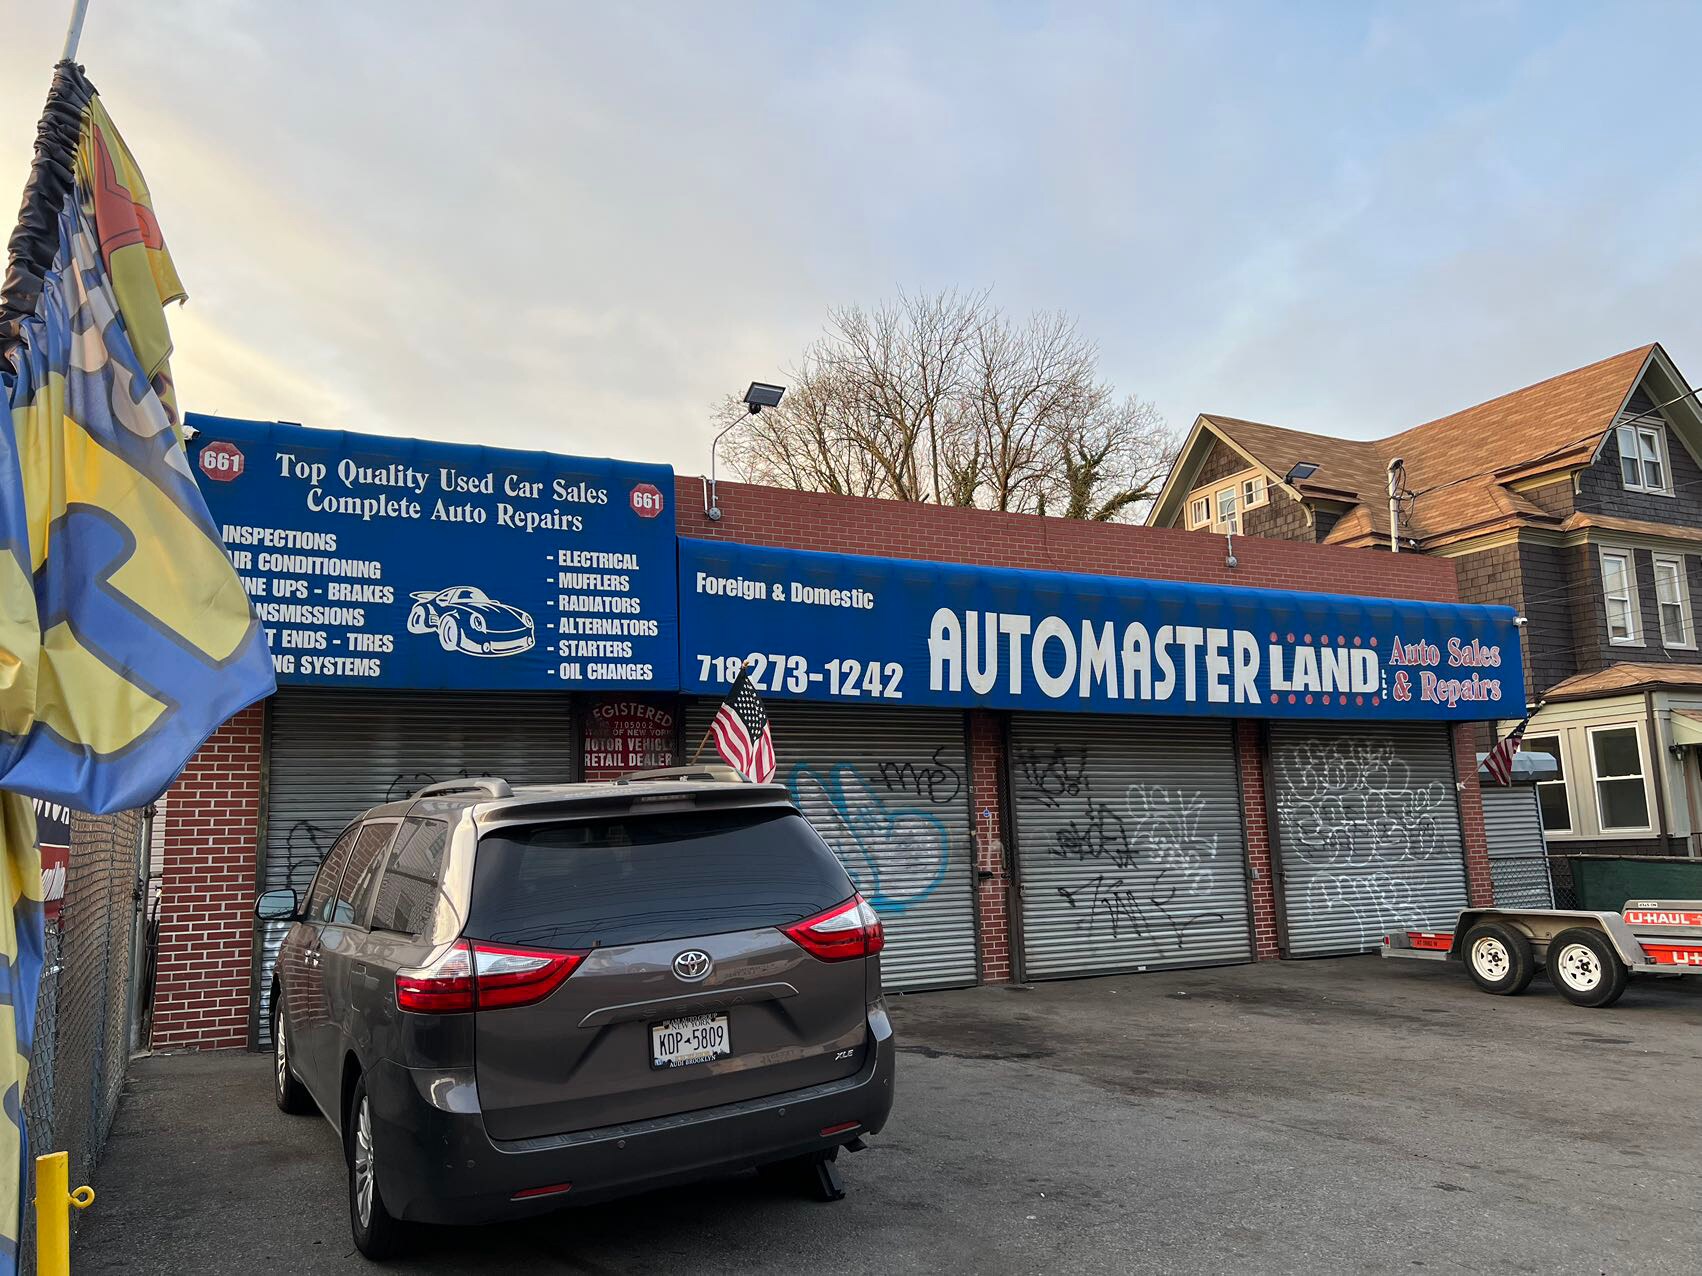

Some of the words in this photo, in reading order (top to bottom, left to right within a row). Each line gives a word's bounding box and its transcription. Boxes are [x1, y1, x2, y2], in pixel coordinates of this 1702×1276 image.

[203, 450, 240, 472] 661
[276, 453, 326, 485] Top
[337, 459, 429, 493] Quality
[440, 469, 494, 494] Used
[504, 475, 543, 498] Car
[553, 479, 608, 505] Sales
[306, 488, 421, 520] Complete
[431, 498, 486, 523] Auto
[497, 503, 583, 532] Repairs
[633, 491, 660, 510] 661
[222, 525, 337, 551] INSPECTIONS
[258, 552, 381, 579] CONDITIONING
[558, 550, 639, 570] ELECTRICAL
[239, 577, 267, 596] NE
[272, 578, 308, 599] UPS
[328, 583, 394, 604] BRAKES
[558, 572, 630, 592] MUFFLERS
[696, 572, 767, 600] Foreign
[771, 583, 786, 601] &
[790, 582, 874, 610] Domestic
[252, 603, 365, 626] NSMISSIONS
[558, 595, 640, 614] RADIATORS
[559, 618, 658, 637] ALTERNATORS
[281, 630, 327, 650] ENDS
[347, 633, 394, 653] TIRES
[559, 640, 633, 658] STARTERS
[1388, 635, 1441, 667] Auto
[1447, 636, 1502, 668] Sales
[301, 656, 380, 677] SYSTEMS
[928, 607, 1262, 704] AUTOMASTER
[1269, 644, 1380, 694] LAND
[559, 663, 583, 680] OIL
[587, 663, 653, 681] CHANGES
[1392, 670, 1412, 702] &
[1418, 671, 1502, 708] Repairs
[592, 702, 673, 727] EGISTERED
[628, 738, 673, 751] VEHICL
[584, 753, 625, 767] RETAIL
[629, 753, 673, 766] DEALER
[1630, 912, 1690, 924] U-HAUL
[690, 1018, 711, 1028] YORK
[659, 1032, 683, 1056] KDP
[692, 1025, 724, 1050] 5809
[834, 1049, 853, 1061] XLE
